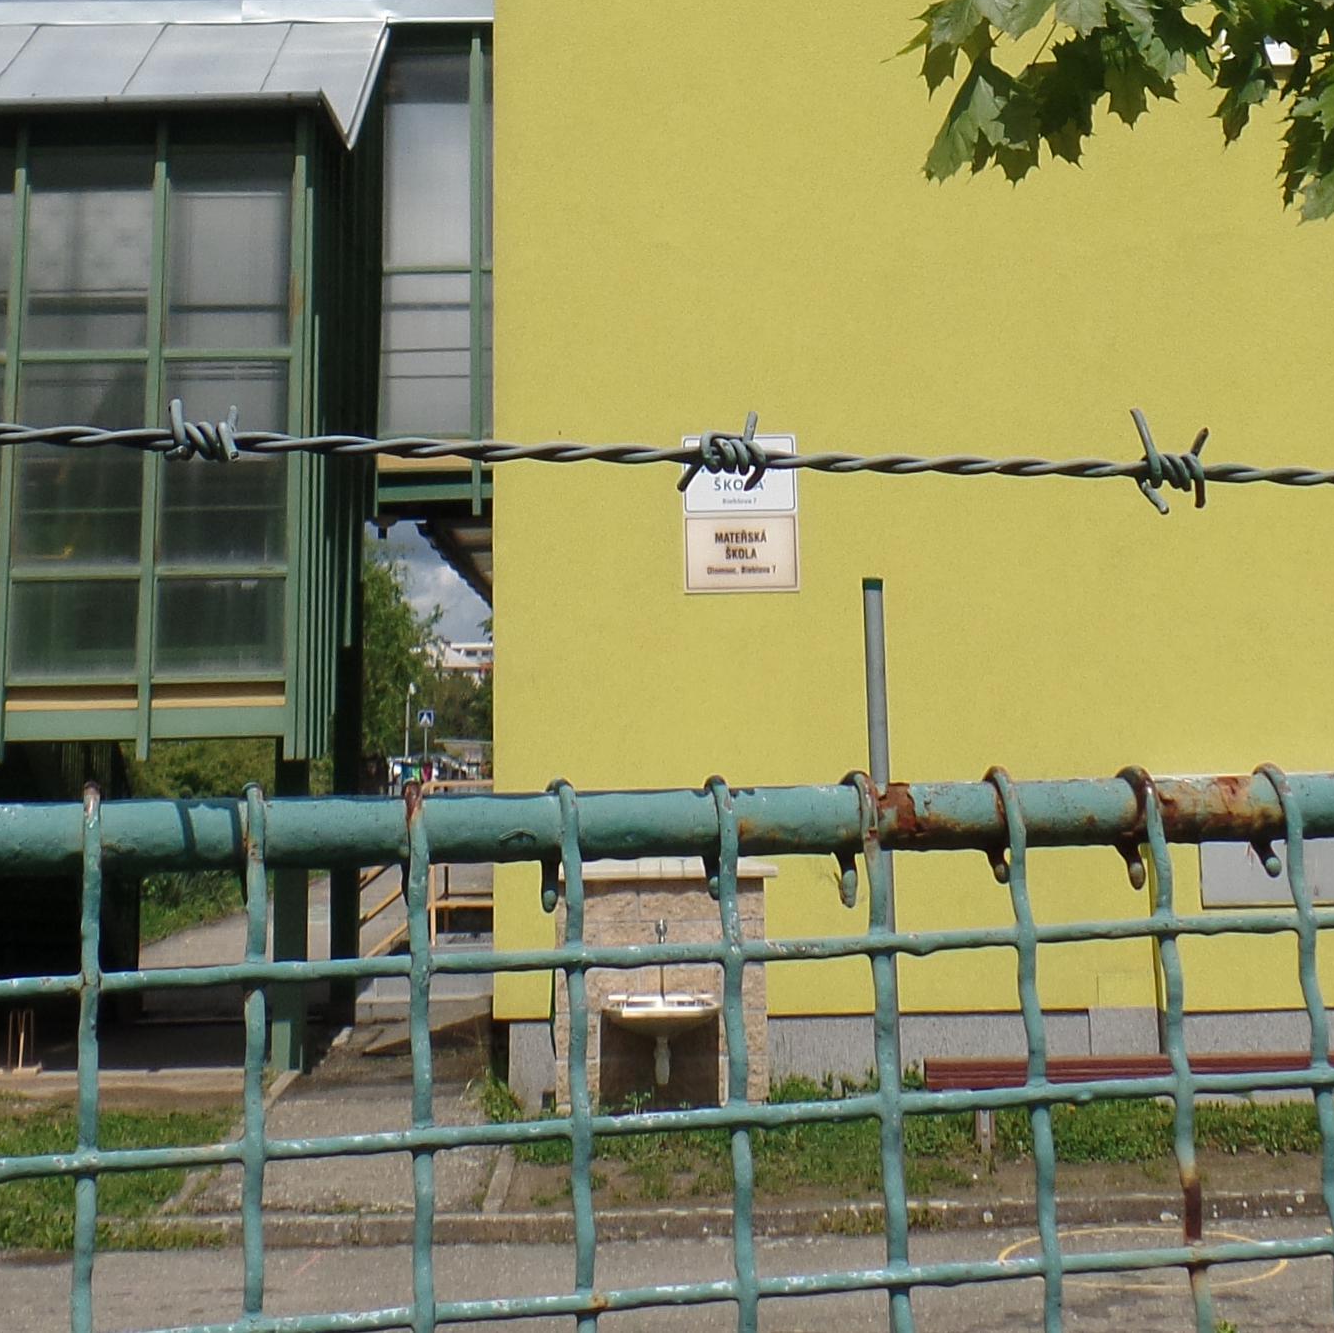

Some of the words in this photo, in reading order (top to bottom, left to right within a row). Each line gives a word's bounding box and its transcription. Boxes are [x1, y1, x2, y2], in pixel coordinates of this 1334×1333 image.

[714, 477, 764, 491] ŠKOA
[714, 529, 767, 543] MATEŘSKÁ
[725, 546, 757, 560] ŠKOLA
